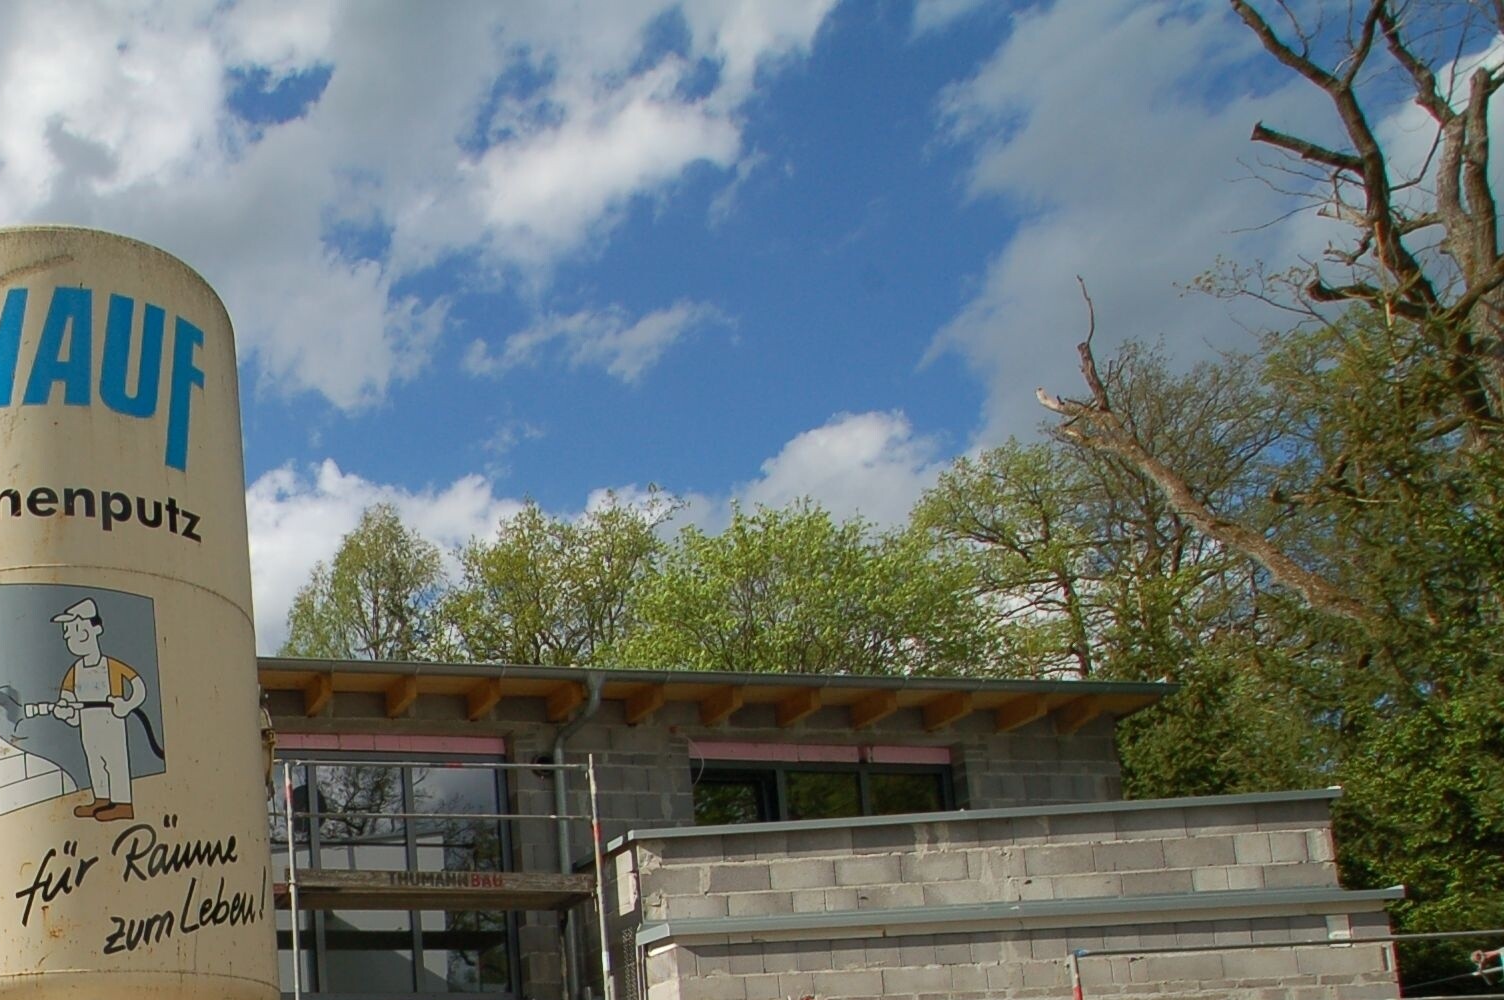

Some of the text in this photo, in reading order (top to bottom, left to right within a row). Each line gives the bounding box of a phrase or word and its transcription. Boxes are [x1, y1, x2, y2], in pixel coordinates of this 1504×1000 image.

[16, 815, 238, 926] für Räume
[104, 867, 267, 954] zum Leben!
